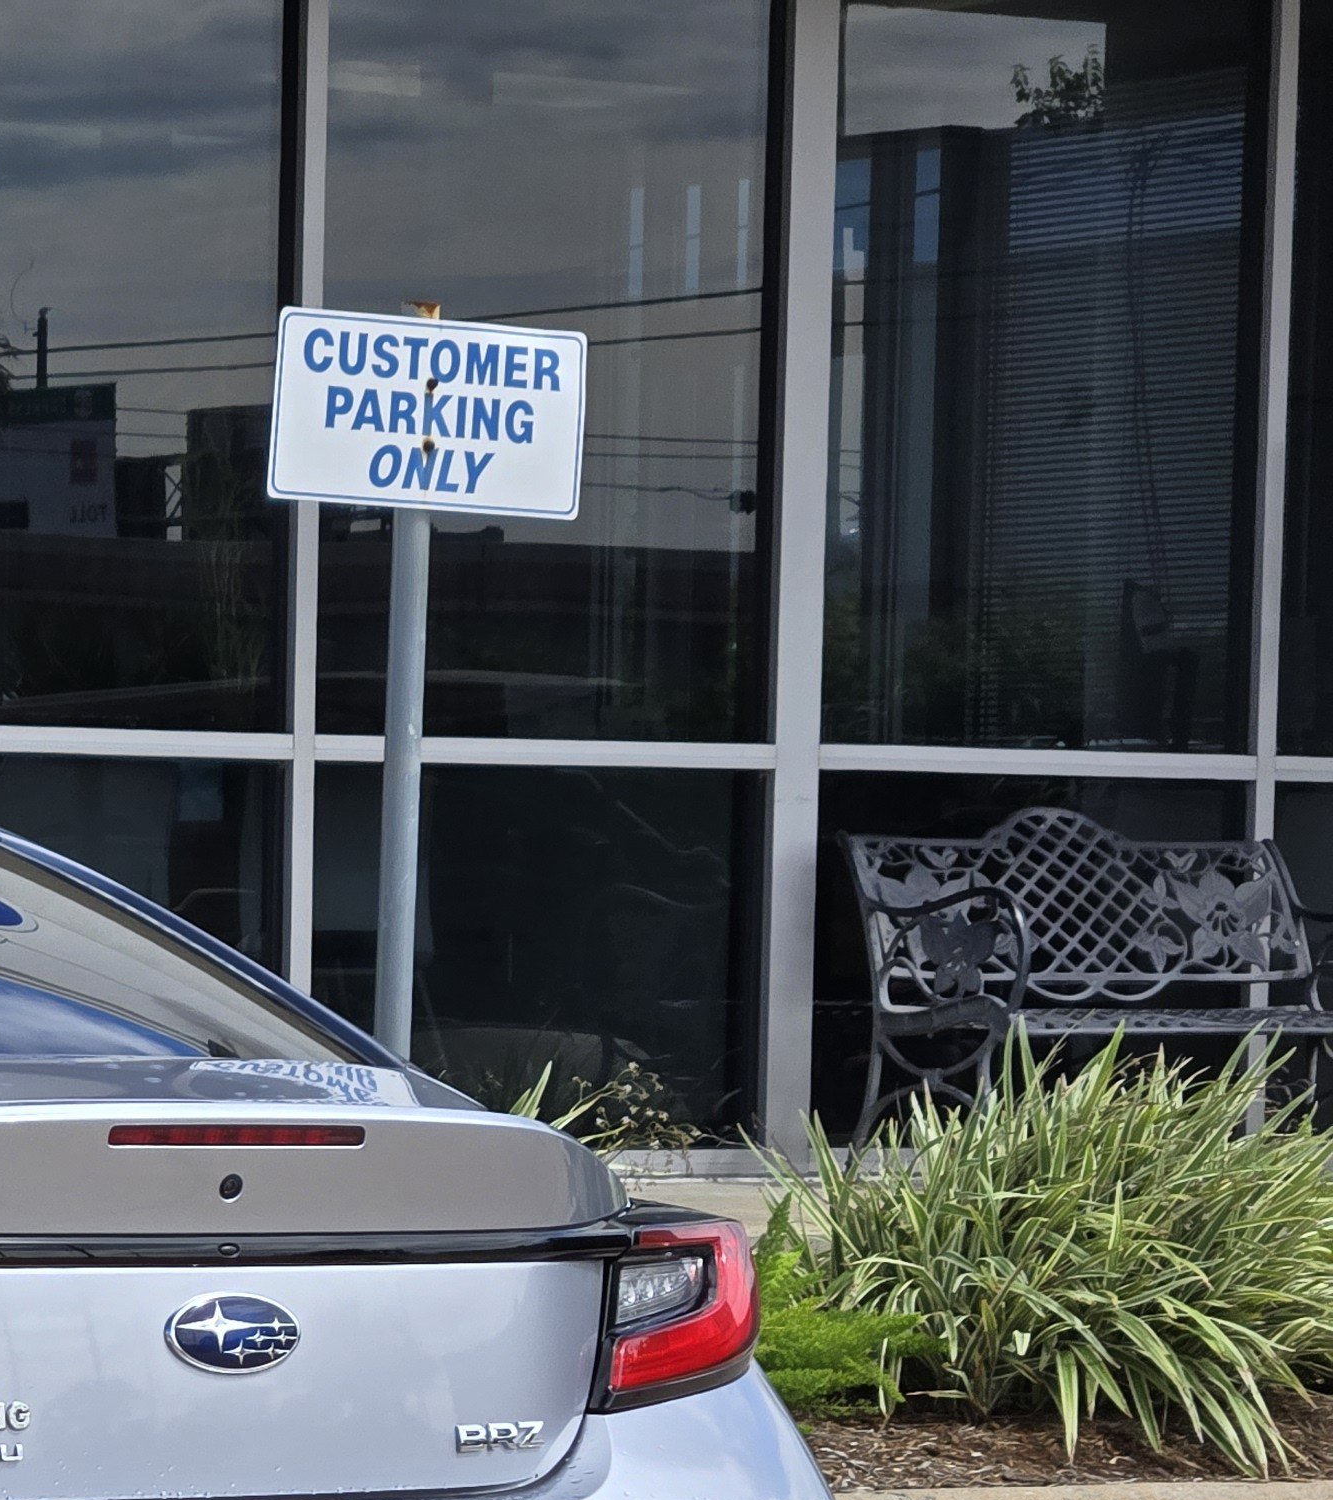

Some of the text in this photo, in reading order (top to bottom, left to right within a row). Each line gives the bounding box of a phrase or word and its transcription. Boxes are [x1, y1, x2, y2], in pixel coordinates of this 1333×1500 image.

[303, 328, 560, 392] CUSTOMER
[324, 385, 534, 444] PARKING
[368, 444, 495, 494] ONLY
[455, 1421, 545, 1454] BRZ
